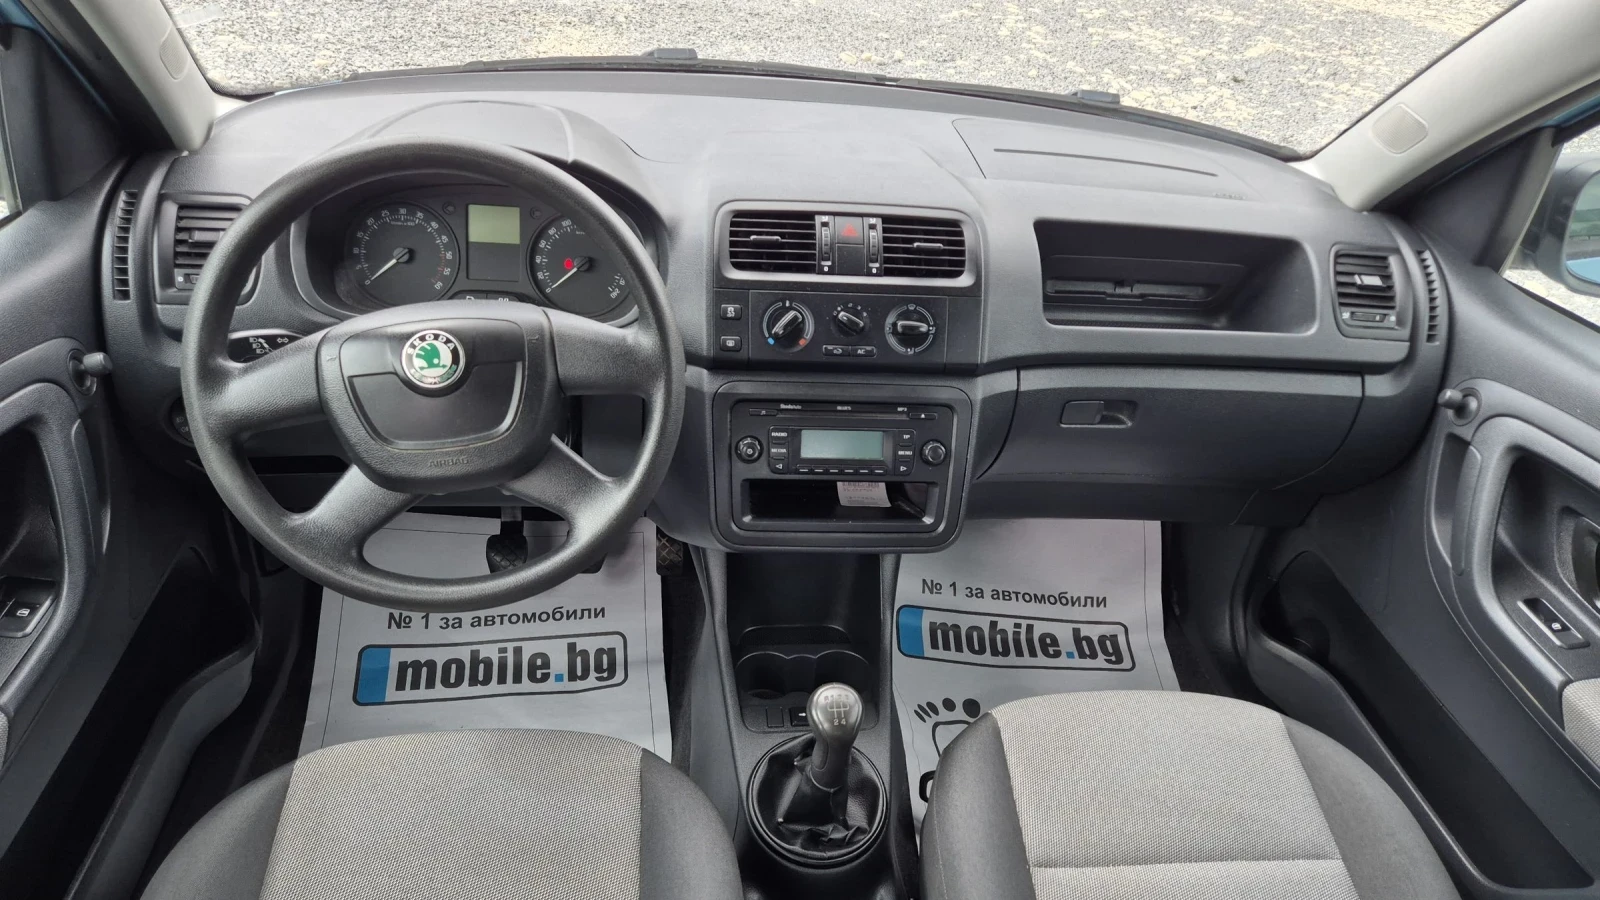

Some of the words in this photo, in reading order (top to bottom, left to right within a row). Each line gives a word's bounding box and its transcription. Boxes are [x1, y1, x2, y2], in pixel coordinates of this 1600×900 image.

[416, 211, 424, 219] 35
[367, 217, 375, 226] 20
[430, 221, 439, 229] 40
[561, 219, 572, 227] 100
[548, 227, 557, 235] 80
[441, 235, 448, 243] 45
[538, 240, 546, 248] 60
[446, 251, 453, 260] 50
[535, 255, 541, 263] 40
[443, 267, 451, 275] 55
[434, 281, 443, 290] 60
[610, 288, 620, 299] 240
[428, 457, 470, 468] AIRBAG
[921, 578, 943, 595] №
[949, 581, 958, 597] 1
[964, 586, 985, 600] за
[990, 588, 1108, 608] автомобили
[387, 611, 413, 630] №
[420, 612, 431, 630] 1
[438, 615, 464, 630] за
[470, 605, 606, 629] автомобили
[928, 620, 1125, 666] mobile.bg
[394, 641, 618, 692] mobile.bg
[833, 718, 839, 726] 2
